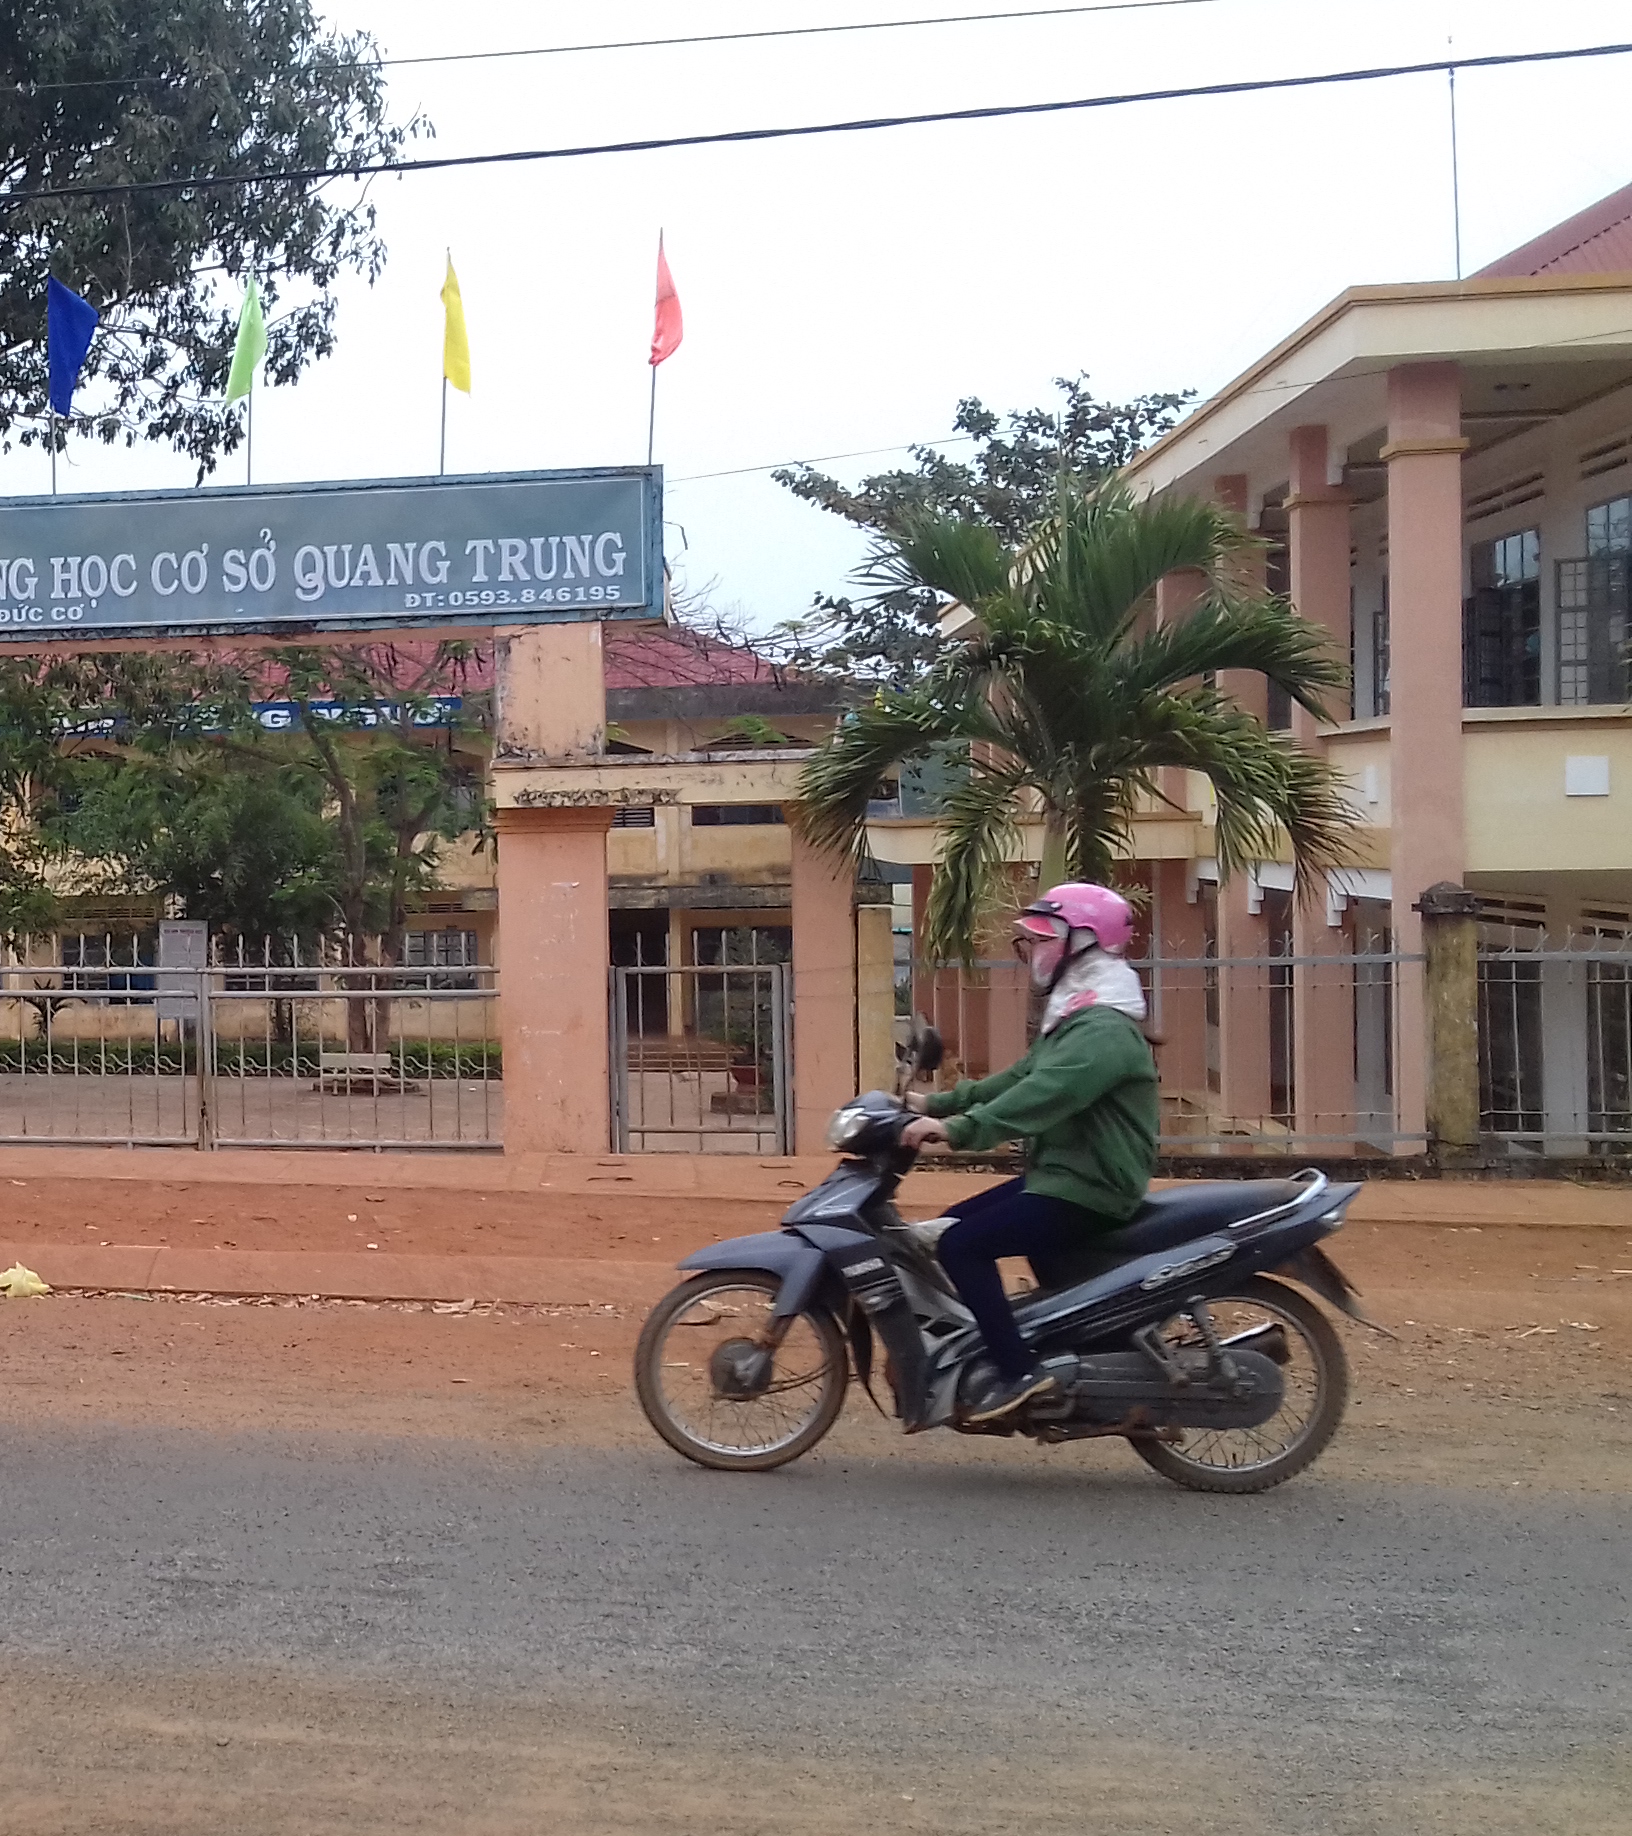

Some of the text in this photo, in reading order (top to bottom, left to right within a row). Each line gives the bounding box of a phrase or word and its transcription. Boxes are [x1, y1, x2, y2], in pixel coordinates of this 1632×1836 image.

[50, 554, 138, 608] HỌC
[151, 543, 209, 596] CƠ
[222, 527, 277, 593] SỞ
[294, 540, 451, 601] QUANG
[465, 532, 627, 583] TRUNG
[50, 603, 85, 621] CƠ
